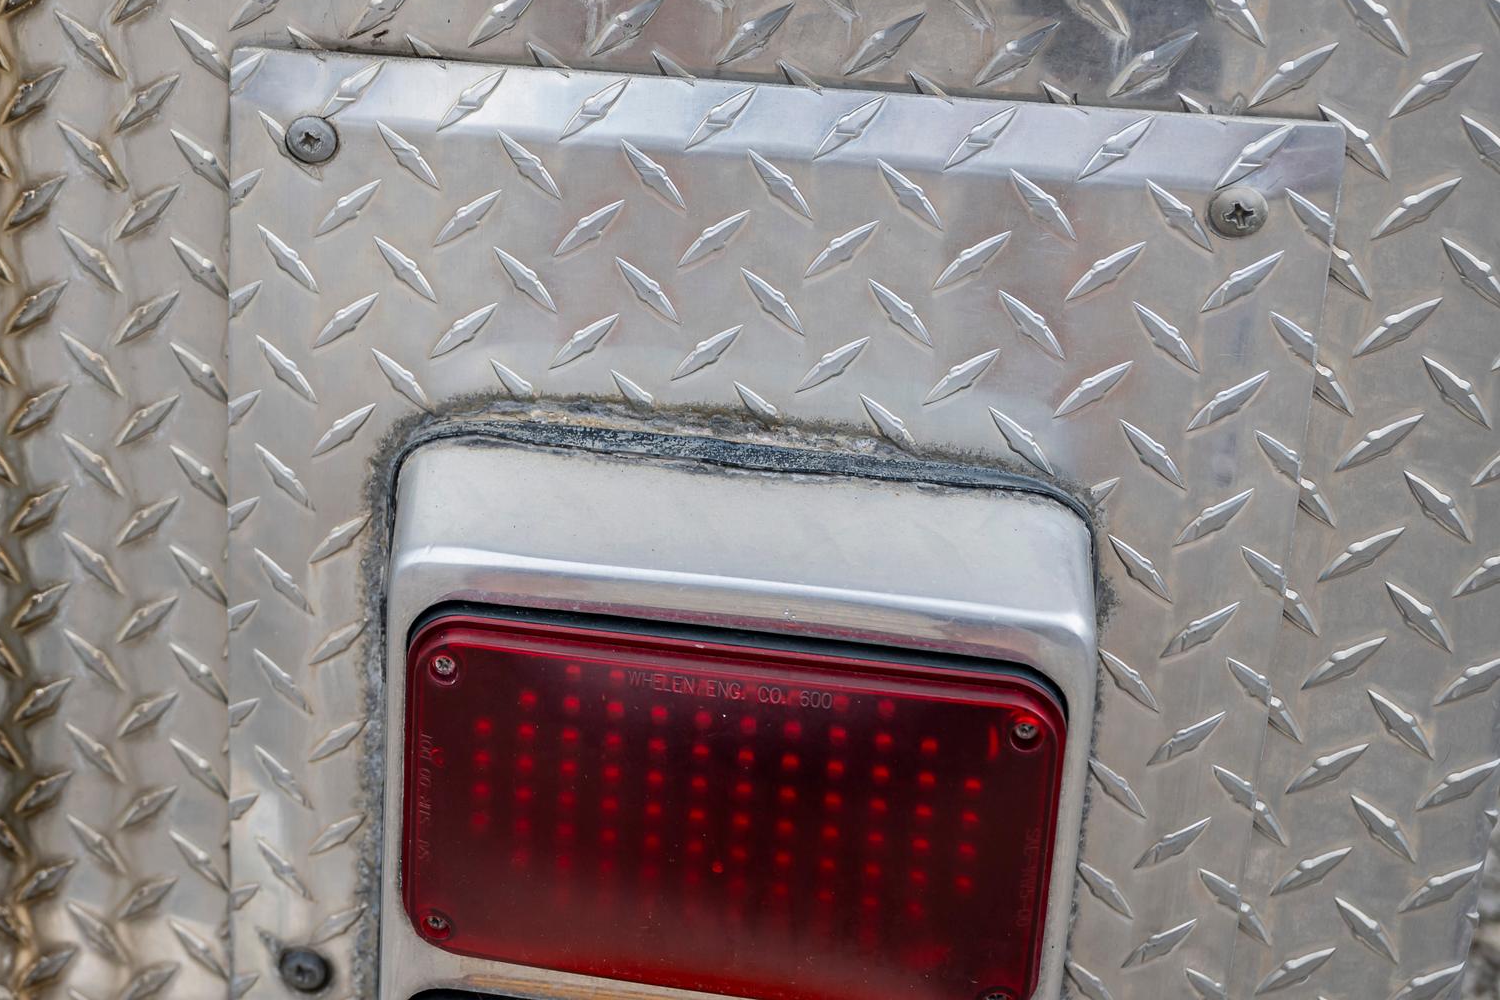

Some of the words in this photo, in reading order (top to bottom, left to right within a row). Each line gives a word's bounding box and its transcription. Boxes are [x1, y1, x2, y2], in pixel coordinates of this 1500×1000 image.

[627, 669, 695, 696] WHELEN
[706, 679, 745, 701] ENG.
[757, 685, 787, 704] CO.
[799, 689, 834, 709] 600
